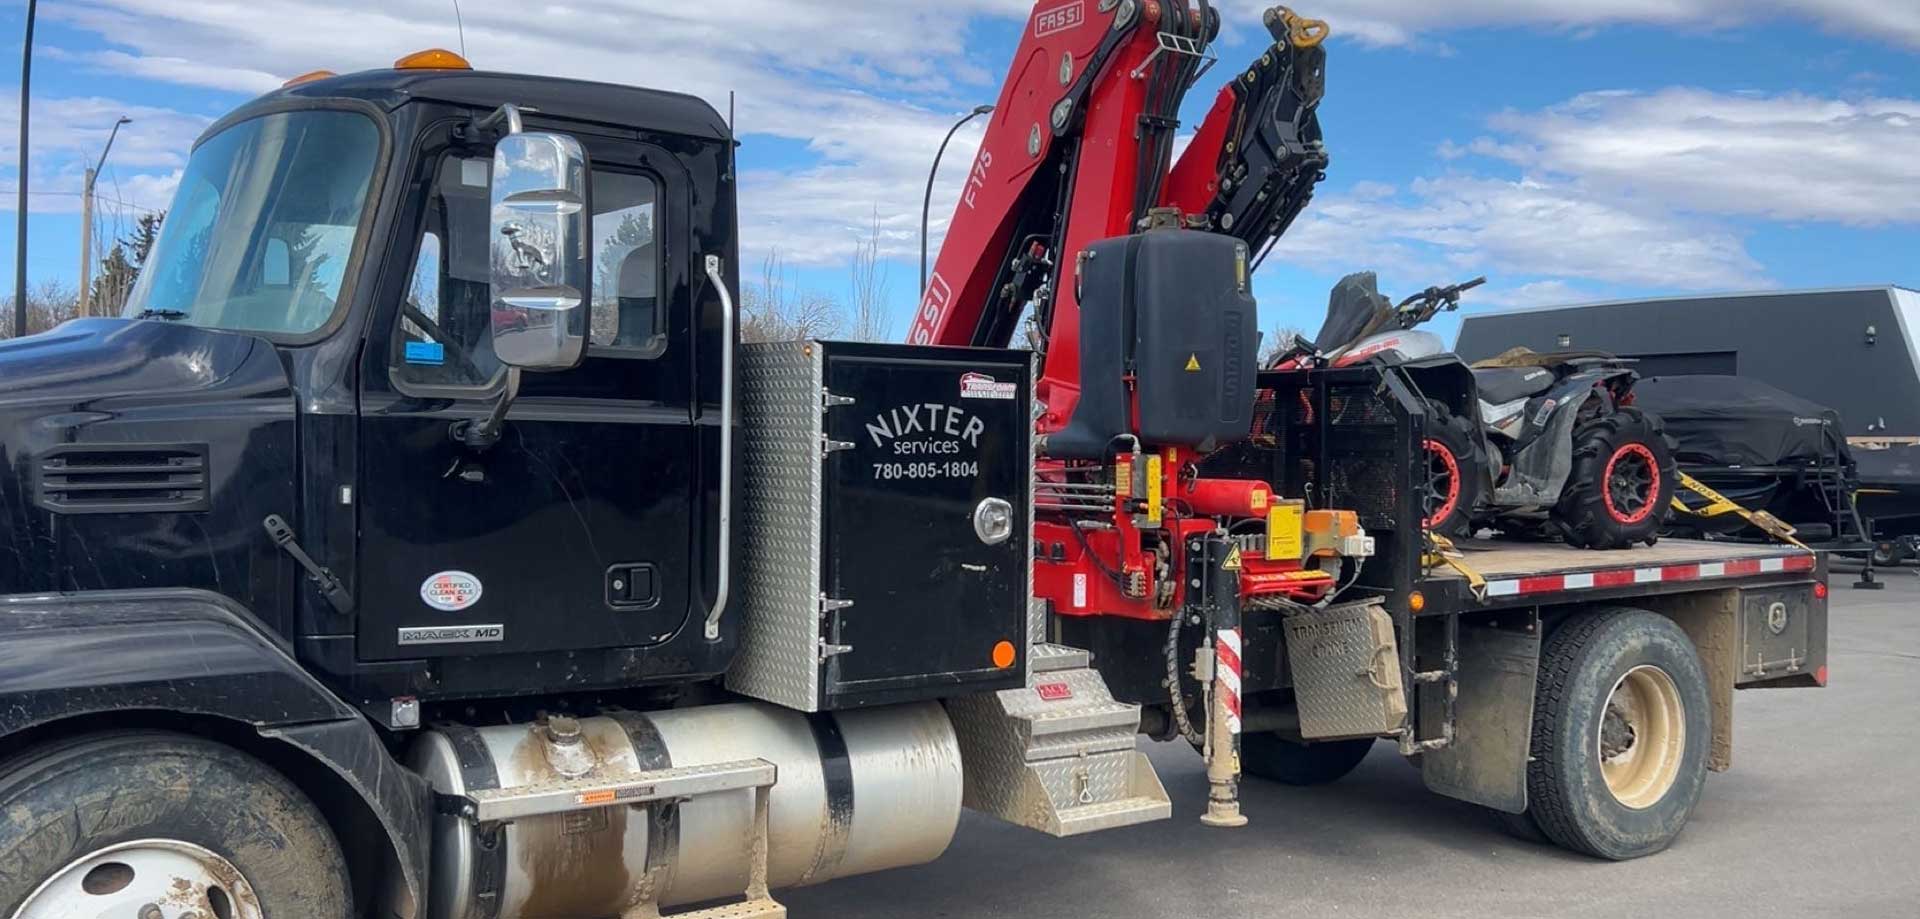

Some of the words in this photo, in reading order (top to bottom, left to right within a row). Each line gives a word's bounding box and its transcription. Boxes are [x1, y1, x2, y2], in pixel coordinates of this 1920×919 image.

[1039, 5, 1080, 32] FASSI
[964, 147, 992, 208] F175
[914, 286, 944, 345] SSI
[865, 402, 985, 448] NIXTER
[893, 436, 960, 454] services
[873, 461, 979, 479] 780-805-1804
[402, 630, 470, 641] MACK
[475, 628, 500, 638] MD
